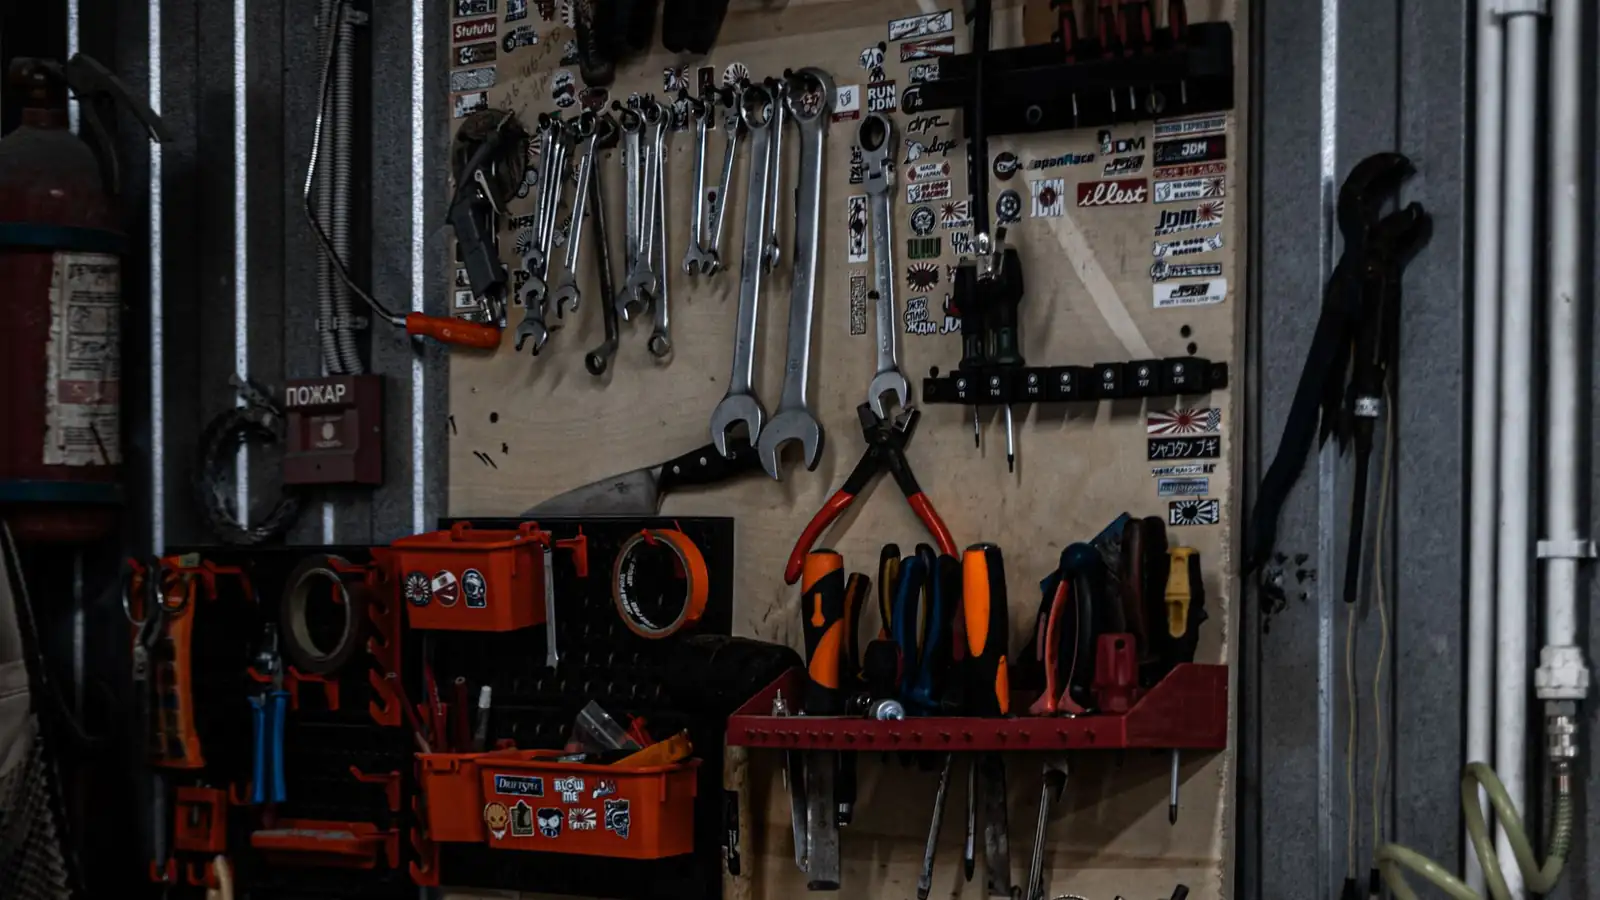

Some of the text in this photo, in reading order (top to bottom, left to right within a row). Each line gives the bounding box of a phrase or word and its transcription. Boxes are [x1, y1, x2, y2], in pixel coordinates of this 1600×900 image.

[455, 22, 495, 38] Stututu
[868, 85, 897, 99] RUN
[868, 97, 897, 113] JDM
[1108, 137, 1145, 155] JDM
[1181, 141, 1208, 157] JDM
[920, 163, 937, 172] MADE
[922, 170, 942, 178] JAPAN
[1183, 180, 1203, 188] GOOD
[1078, 182, 1147, 207] illest
[1174, 189, 1201, 199] RACING
[1182, 237, 1205, 246] GOOD
[1172, 246, 1203, 257] RACING
[907, 321, 937, 336] ЖДМ
[286, 384, 346, 407] ПОЖАР
[1151, 441, 1193, 459] シャコタン
[563, 790, 579, 803] ME
